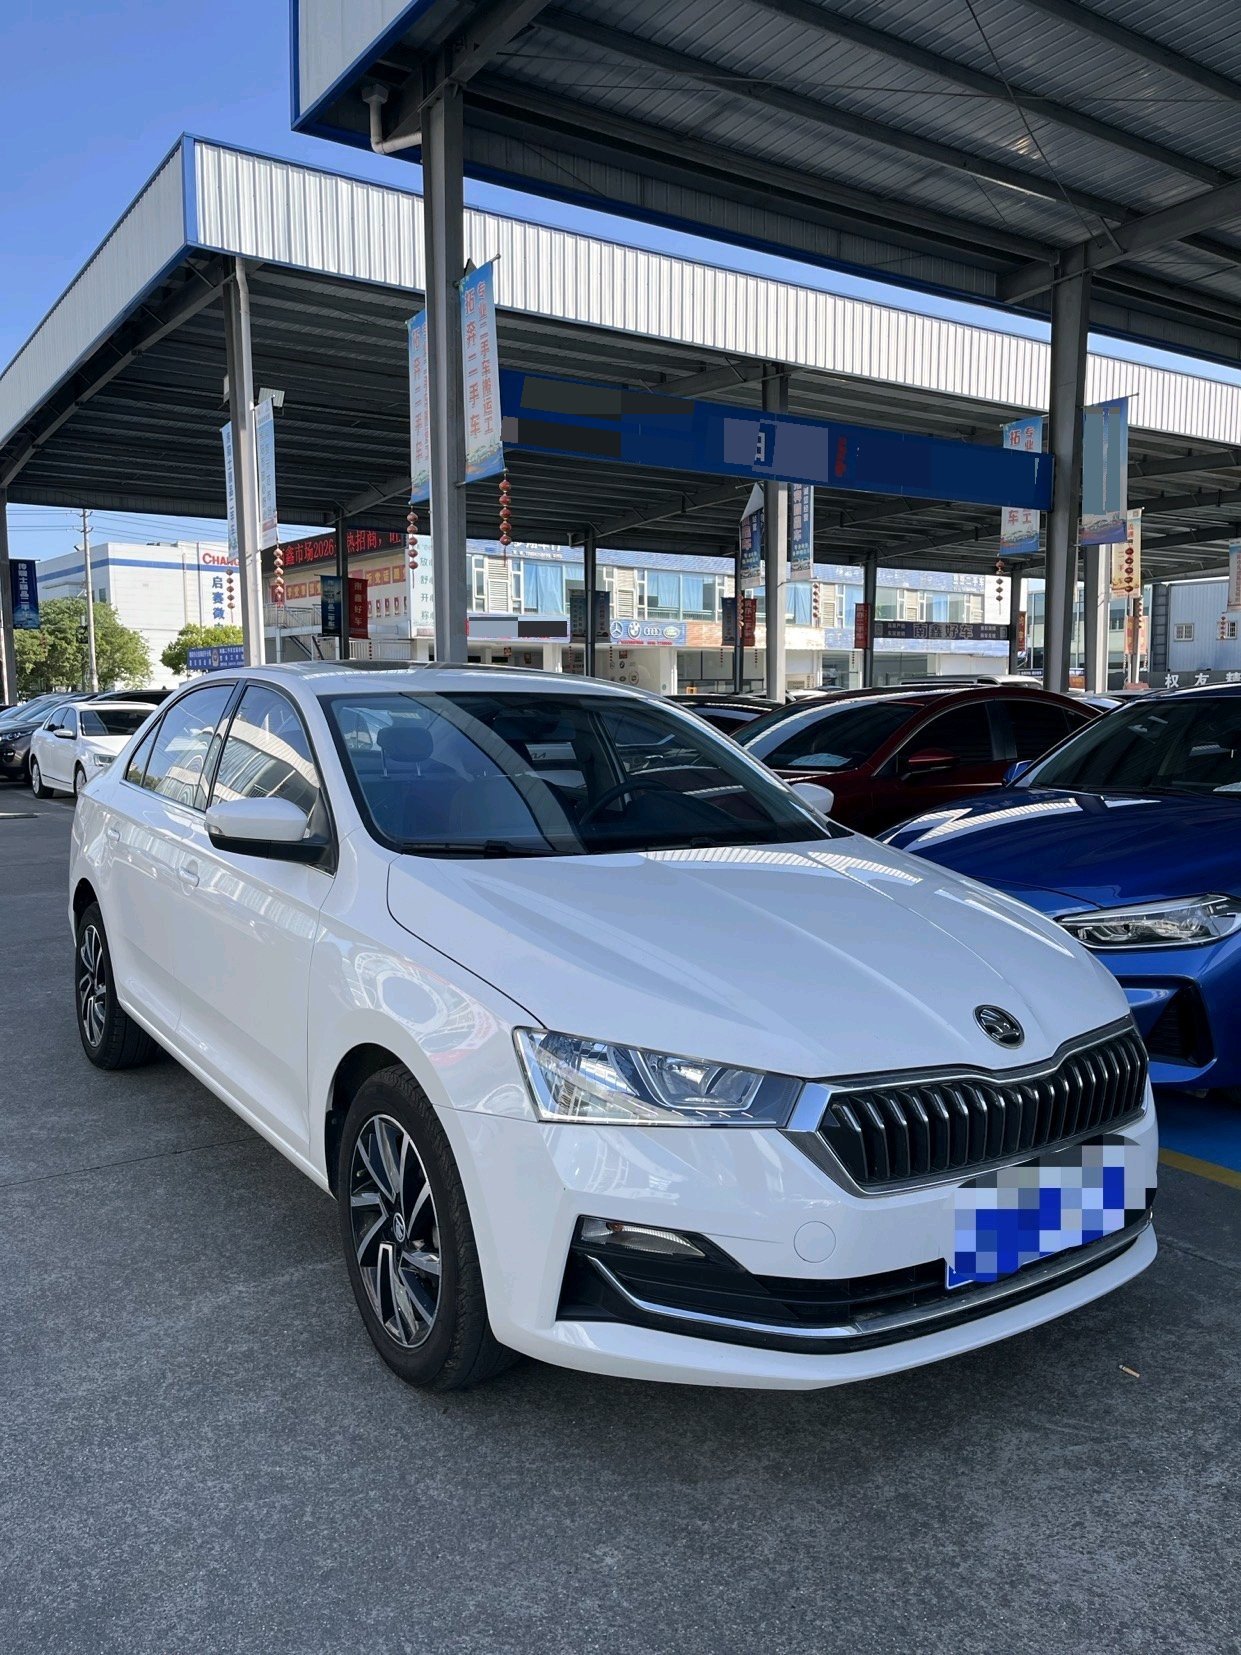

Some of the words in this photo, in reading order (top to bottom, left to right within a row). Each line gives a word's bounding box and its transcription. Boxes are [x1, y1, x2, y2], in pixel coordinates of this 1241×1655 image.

[211, 576, 225, 628] 启赛微
[912, 623, 974, 640] 南鑫好车
